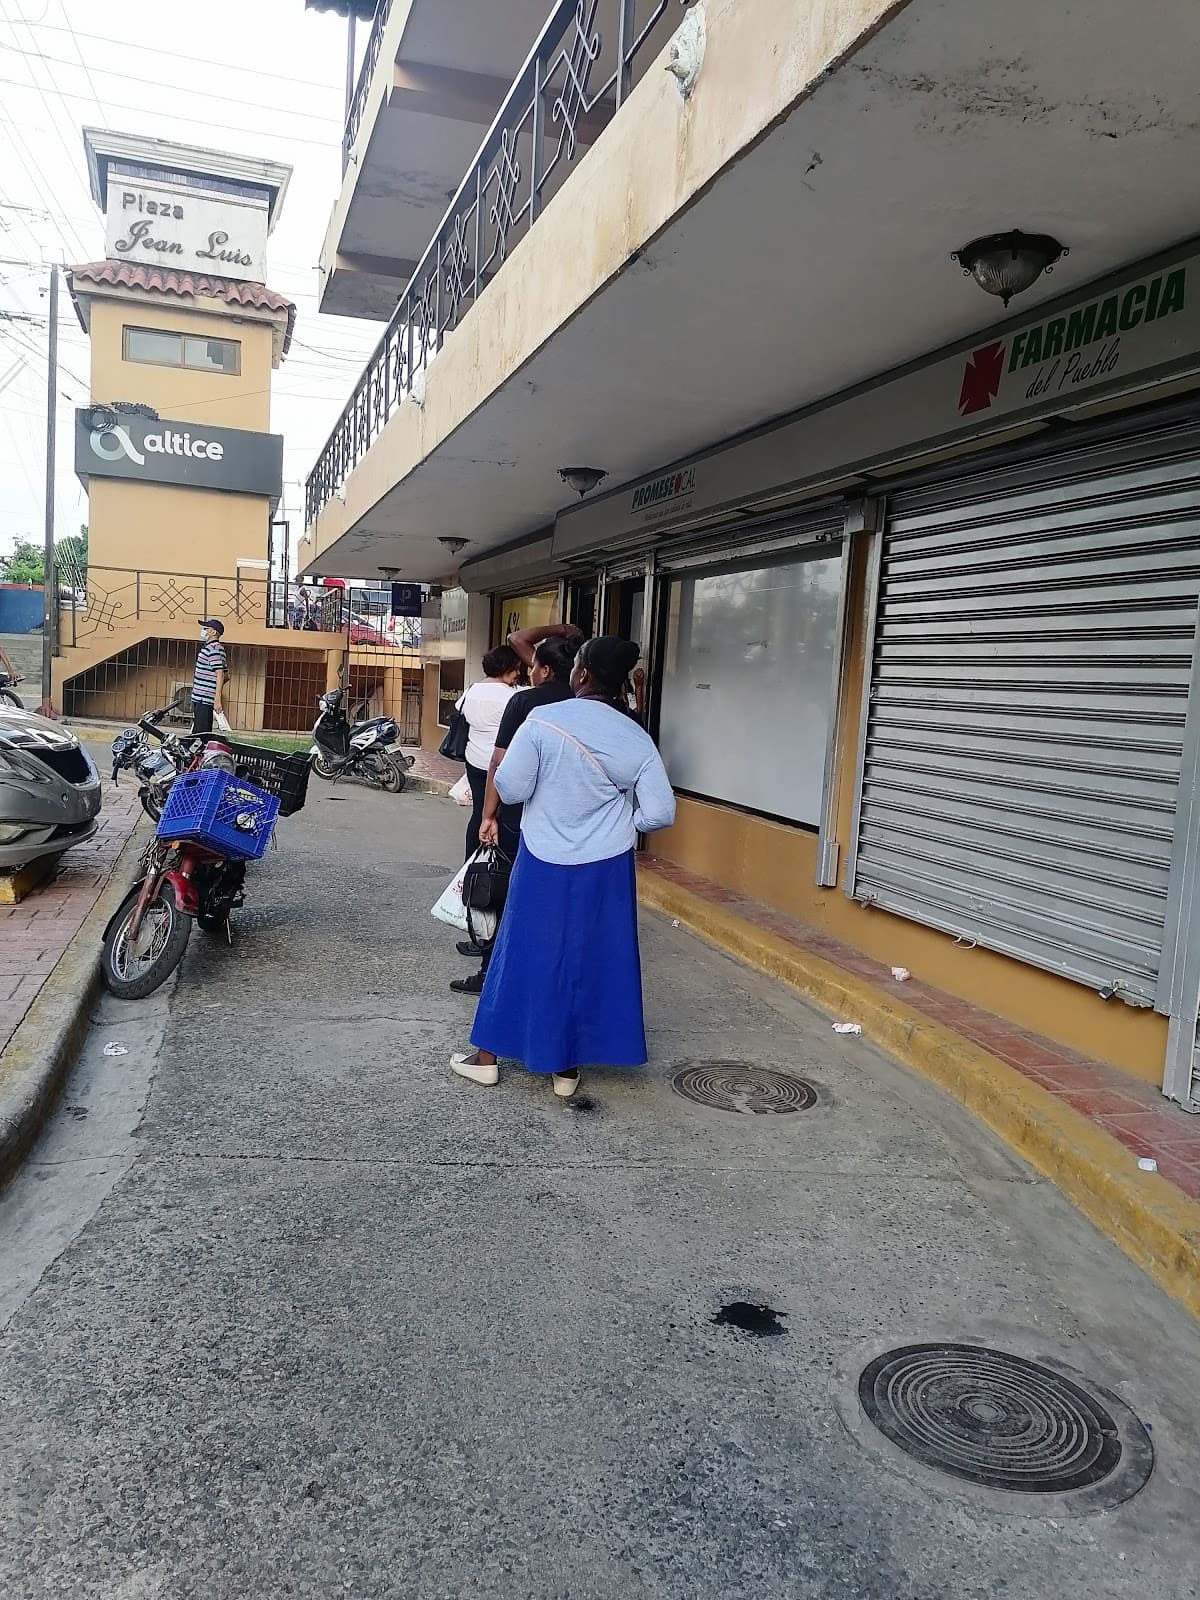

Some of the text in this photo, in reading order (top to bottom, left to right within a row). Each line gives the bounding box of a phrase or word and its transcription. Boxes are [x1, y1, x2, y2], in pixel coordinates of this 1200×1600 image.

[122, 191, 185, 220] Plaza
[114, 219, 253, 267] Jean Luis
[1008, 267, 1186, 374] FARMACIA
[1025, 337, 1121, 400] del Pueblo
[143, 430, 224, 461] altice
[632, 477, 676, 508] PROMESE
